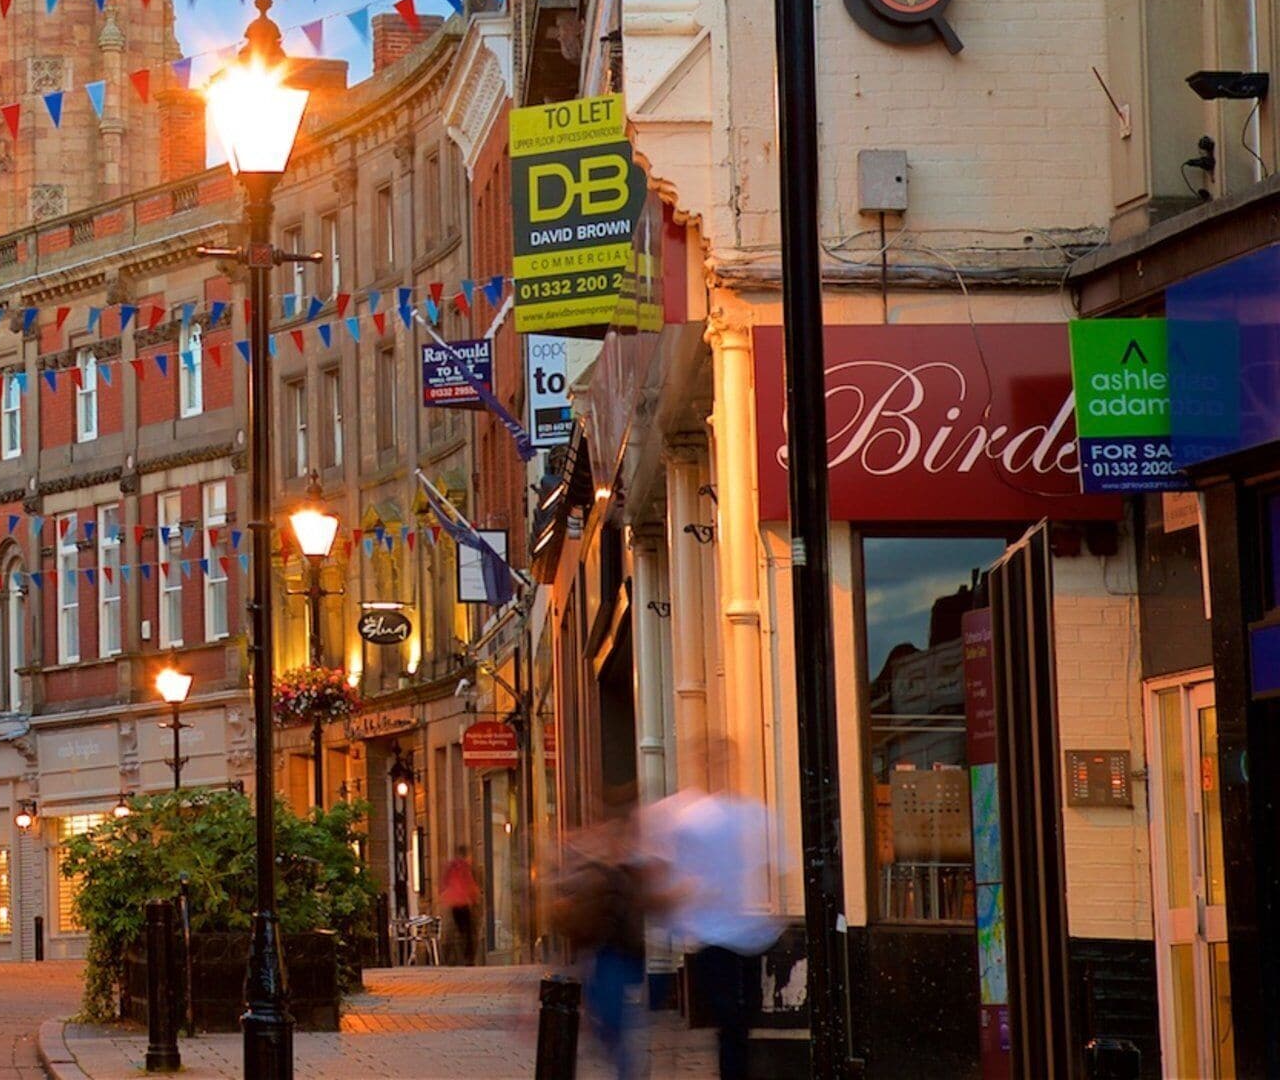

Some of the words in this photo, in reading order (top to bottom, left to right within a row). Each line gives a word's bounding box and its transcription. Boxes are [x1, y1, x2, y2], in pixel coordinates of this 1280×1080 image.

[544, 105, 571, 130] TO
[578, 98, 615, 125] LET
[530, 228, 573, 246] DAVID
[577, 219, 631, 240] BROWN
[520, 279, 571, 300] 01332
[576, 274, 608, 294] 200
[436, 366, 452, 377] TO
[453, 365, 476, 376] LT
[533, 367, 565, 395] to
[1091, 368, 1168, 391] ashle
[1088, 395, 1170, 416] adam
[1091, 444, 1137, 460] FOR
[1143, 443, 1172, 459] SA
[1092, 462, 1138, 477] 01332
